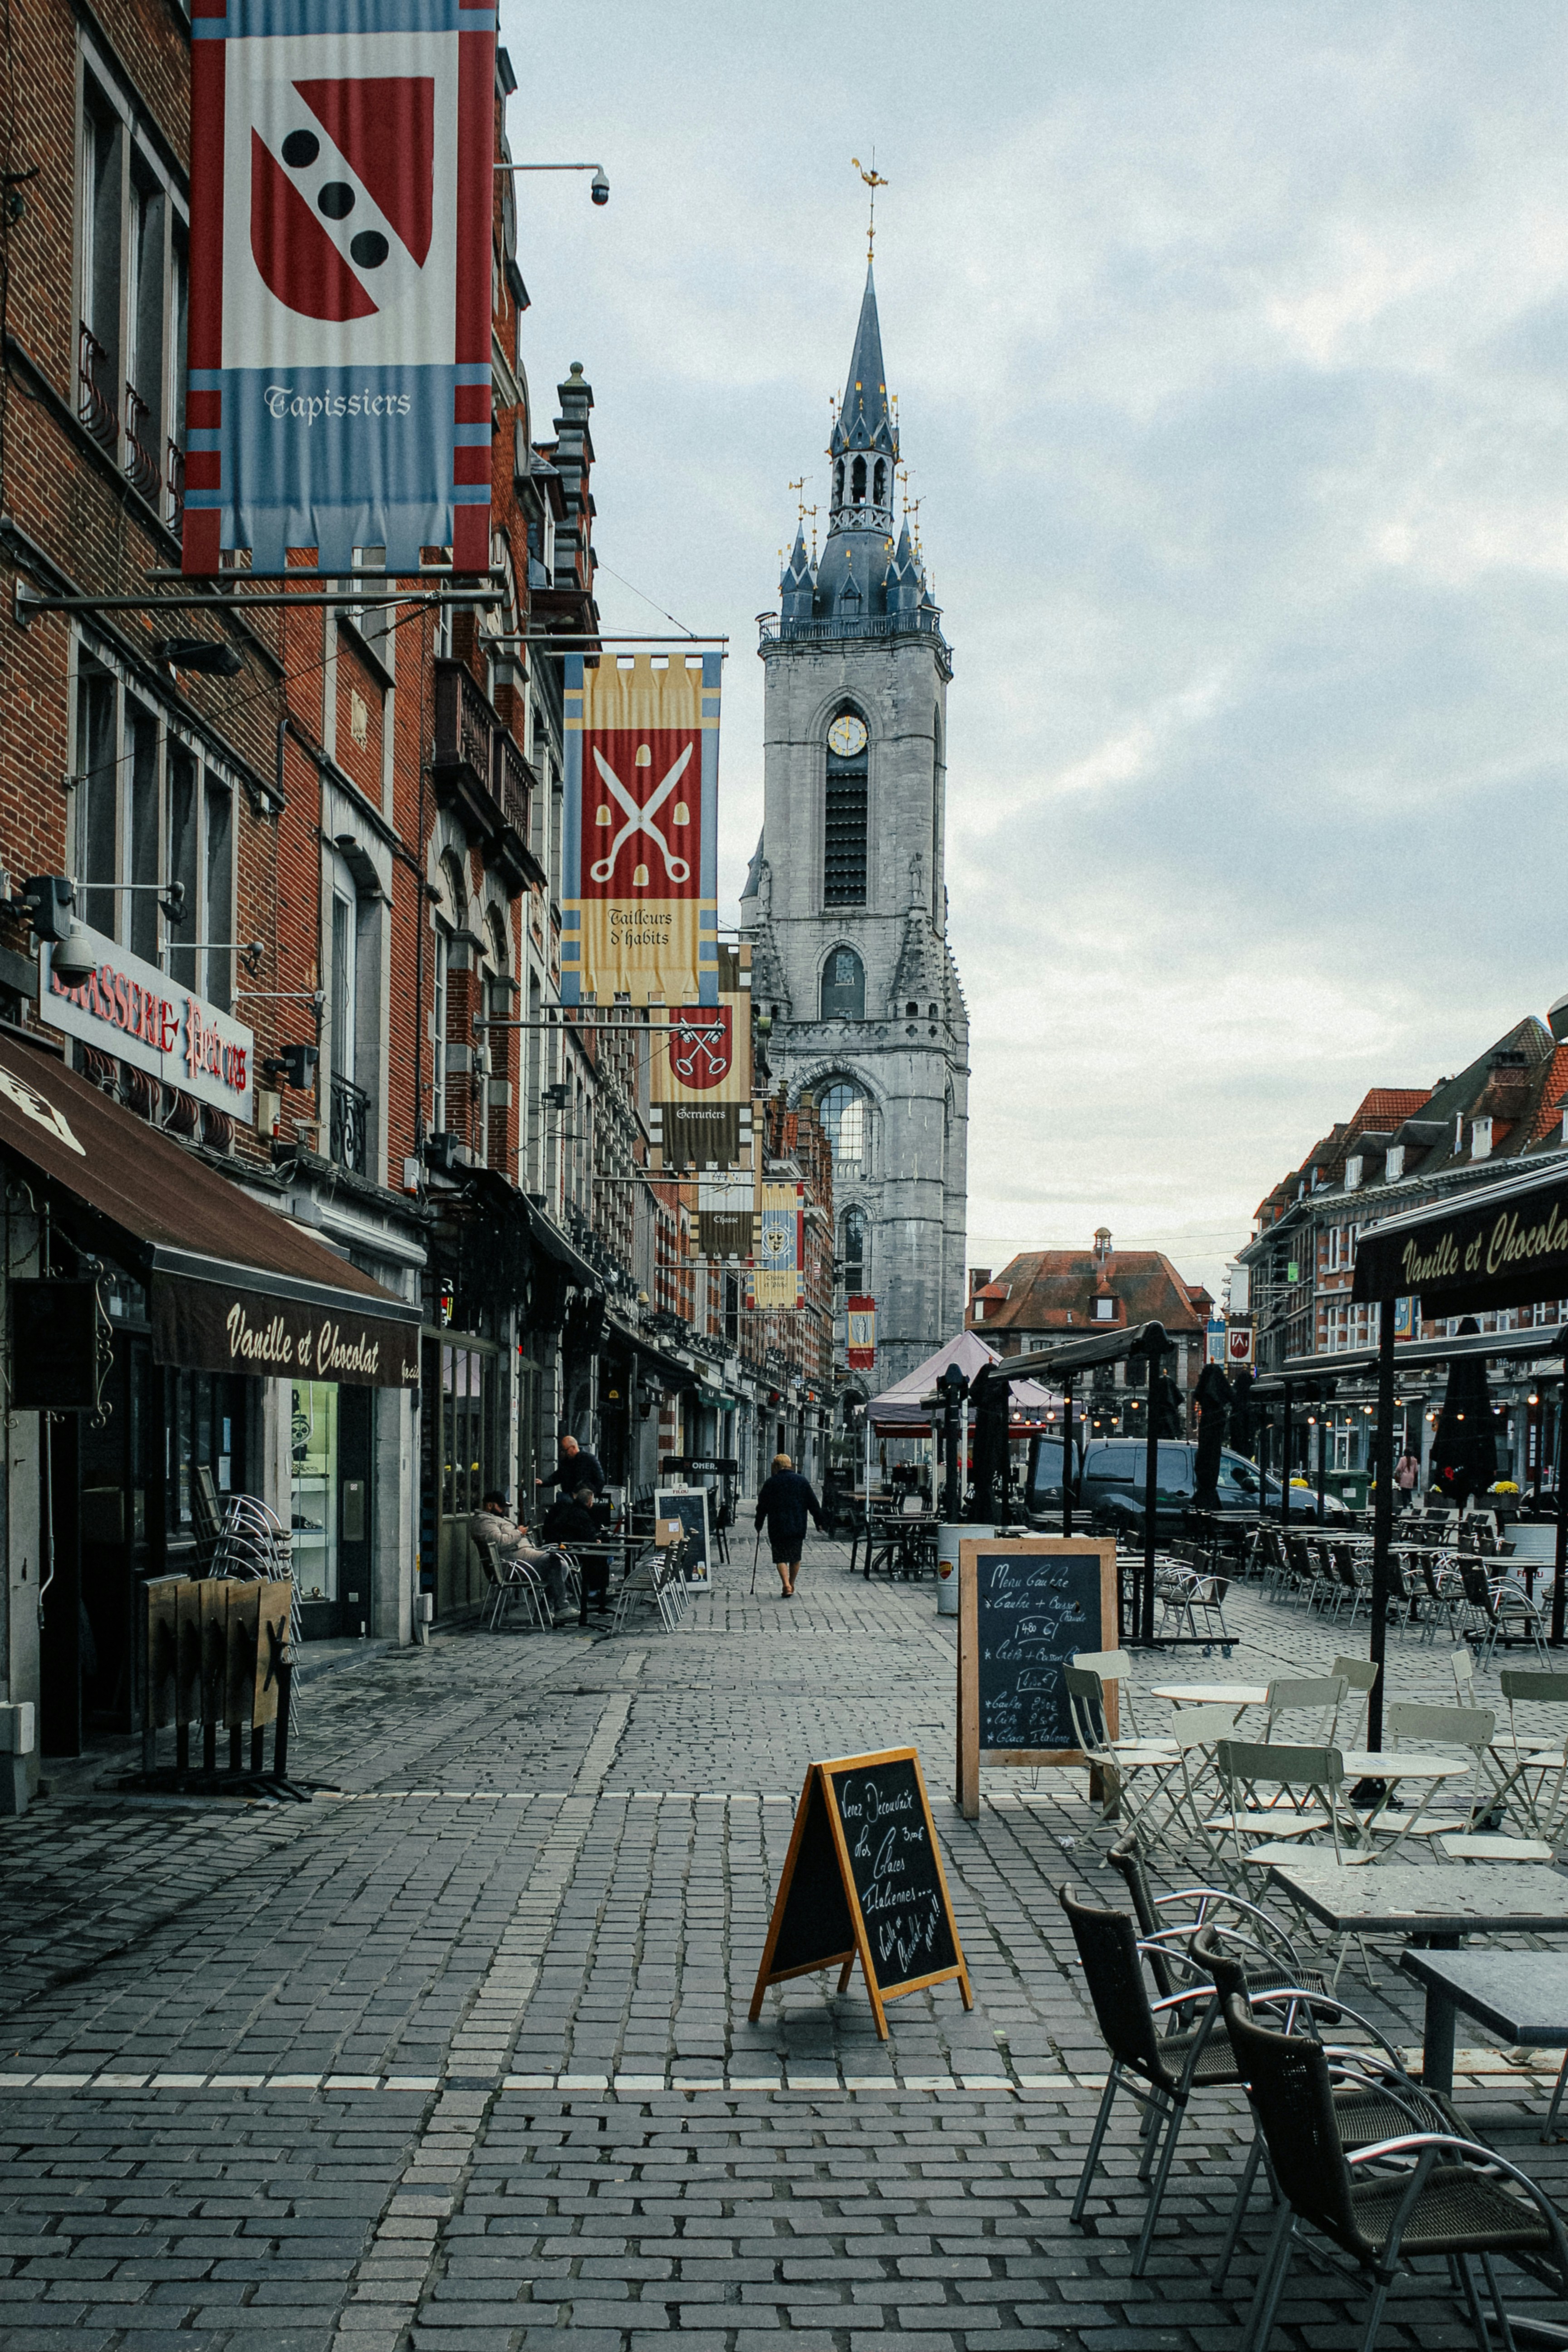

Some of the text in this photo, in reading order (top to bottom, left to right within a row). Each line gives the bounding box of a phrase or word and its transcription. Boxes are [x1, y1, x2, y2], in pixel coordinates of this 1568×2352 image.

[264, 386, 411, 426] Tapissiers
[608, 909, 672, 926] Tailleurs
[611, 929, 669, 950] d'habits
[186, 997, 246, 1096] Petrus
[676, 1107, 725, 1119] Serruriers
[714, 1215, 738, 1225] Chasse
[1402, 1233, 1459, 1284] Vanille
[1465, 1232, 1482, 1271] et
[227, 1303, 292, 1363] Vanille
[298, 1330, 312, 1366] et
[317, 1321, 379, 1375] Chocolat
[990, 1563, 1022, 1588] Menu
[841, 1780, 862, 1818] Venez
